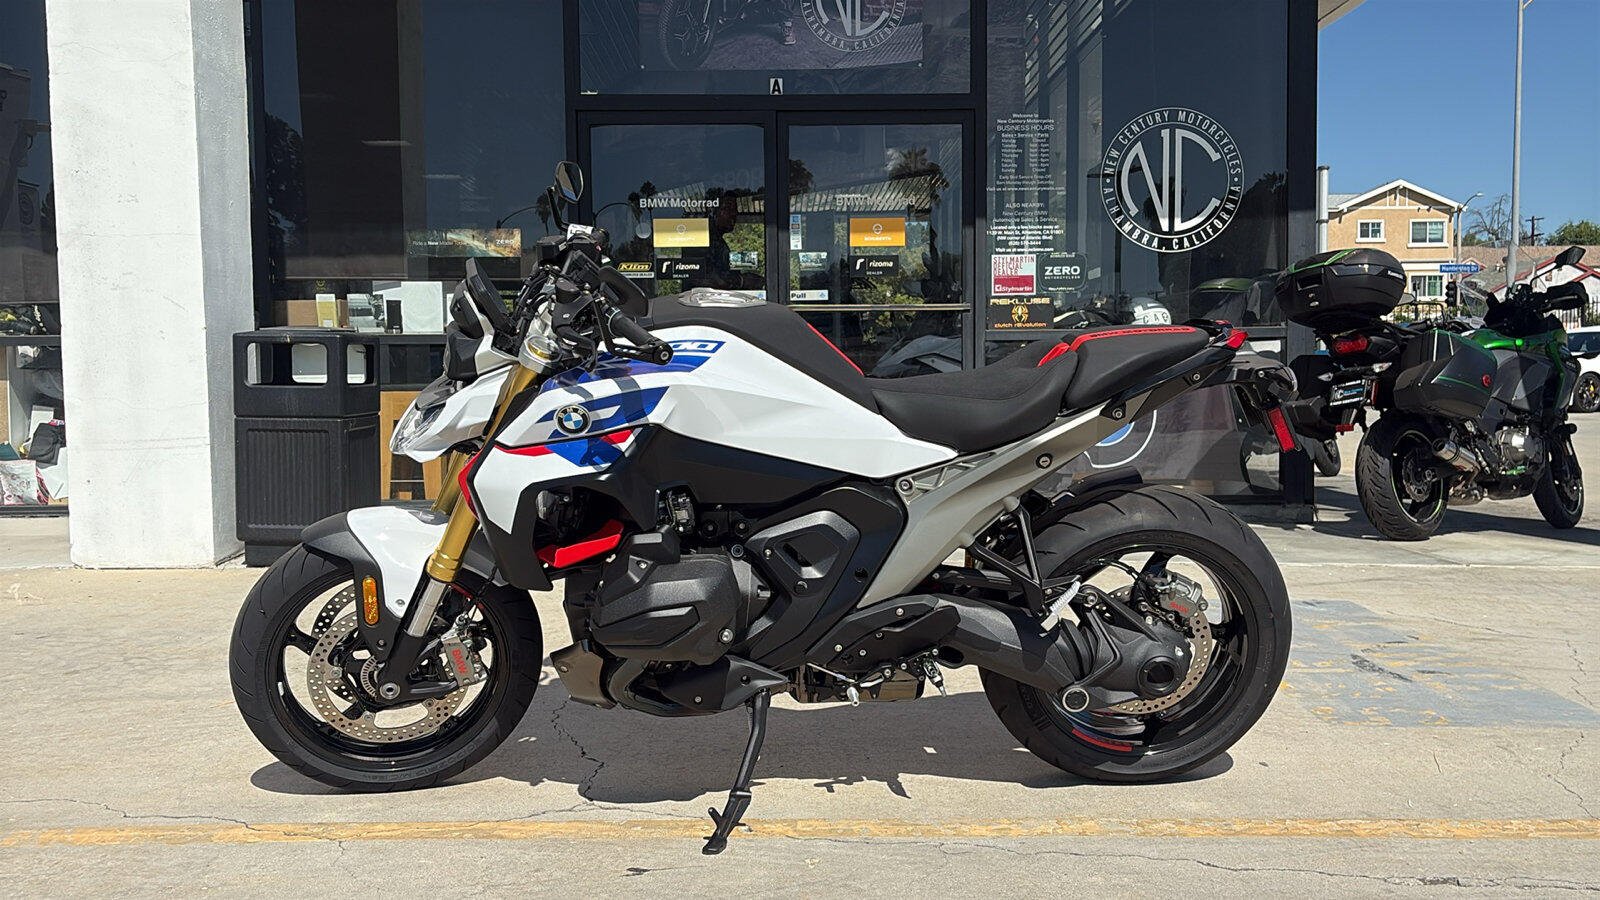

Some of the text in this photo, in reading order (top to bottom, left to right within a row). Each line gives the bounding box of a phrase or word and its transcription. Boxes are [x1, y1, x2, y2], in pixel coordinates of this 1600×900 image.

[771, 78, 782, 95] A
[996, 124, 1030, 132] BUSINESS
[1103, 110, 1242, 175] NEW CENTURY MOTORCYCLES
[639, 197, 720, 209] BMW Motorrad
[836, 196, 867, 207] BMW
[1103, 185, 1242, 251] ALHAMBRA, CALIFORNIA
[869, 259, 894, 267] rizoma
[993, 255, 1034, 264] STYLMARTIN
[675, 262, 700, 270] rizoma
[1044, 265, 1081, 275] ZERO
[990, 297, 1051, 306] REKLUSE
[451, 648, 468, 675] BMW
